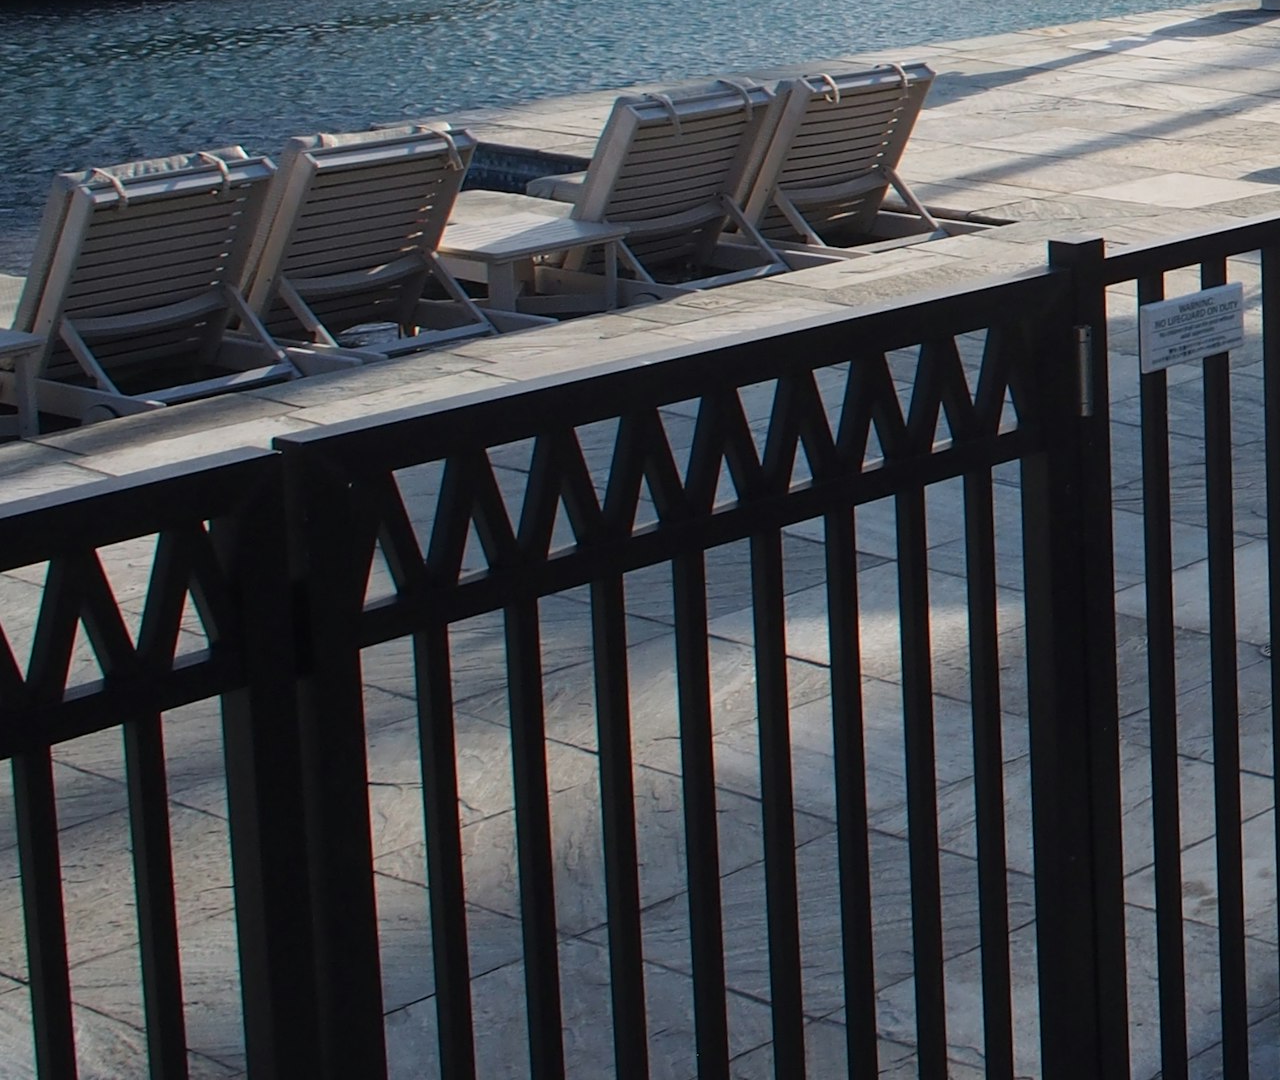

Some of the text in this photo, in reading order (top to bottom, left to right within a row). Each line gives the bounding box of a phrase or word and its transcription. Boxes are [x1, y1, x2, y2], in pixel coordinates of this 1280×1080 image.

[1154, 318, 1167, 329] NO
[1167, 309, 1206, 326] LIFEGUARD
[1207, 305, 1218, 316] ON
[1219, 300, 1239, 312] DUTY
[1178, 297, 1215, 313] WARNING
